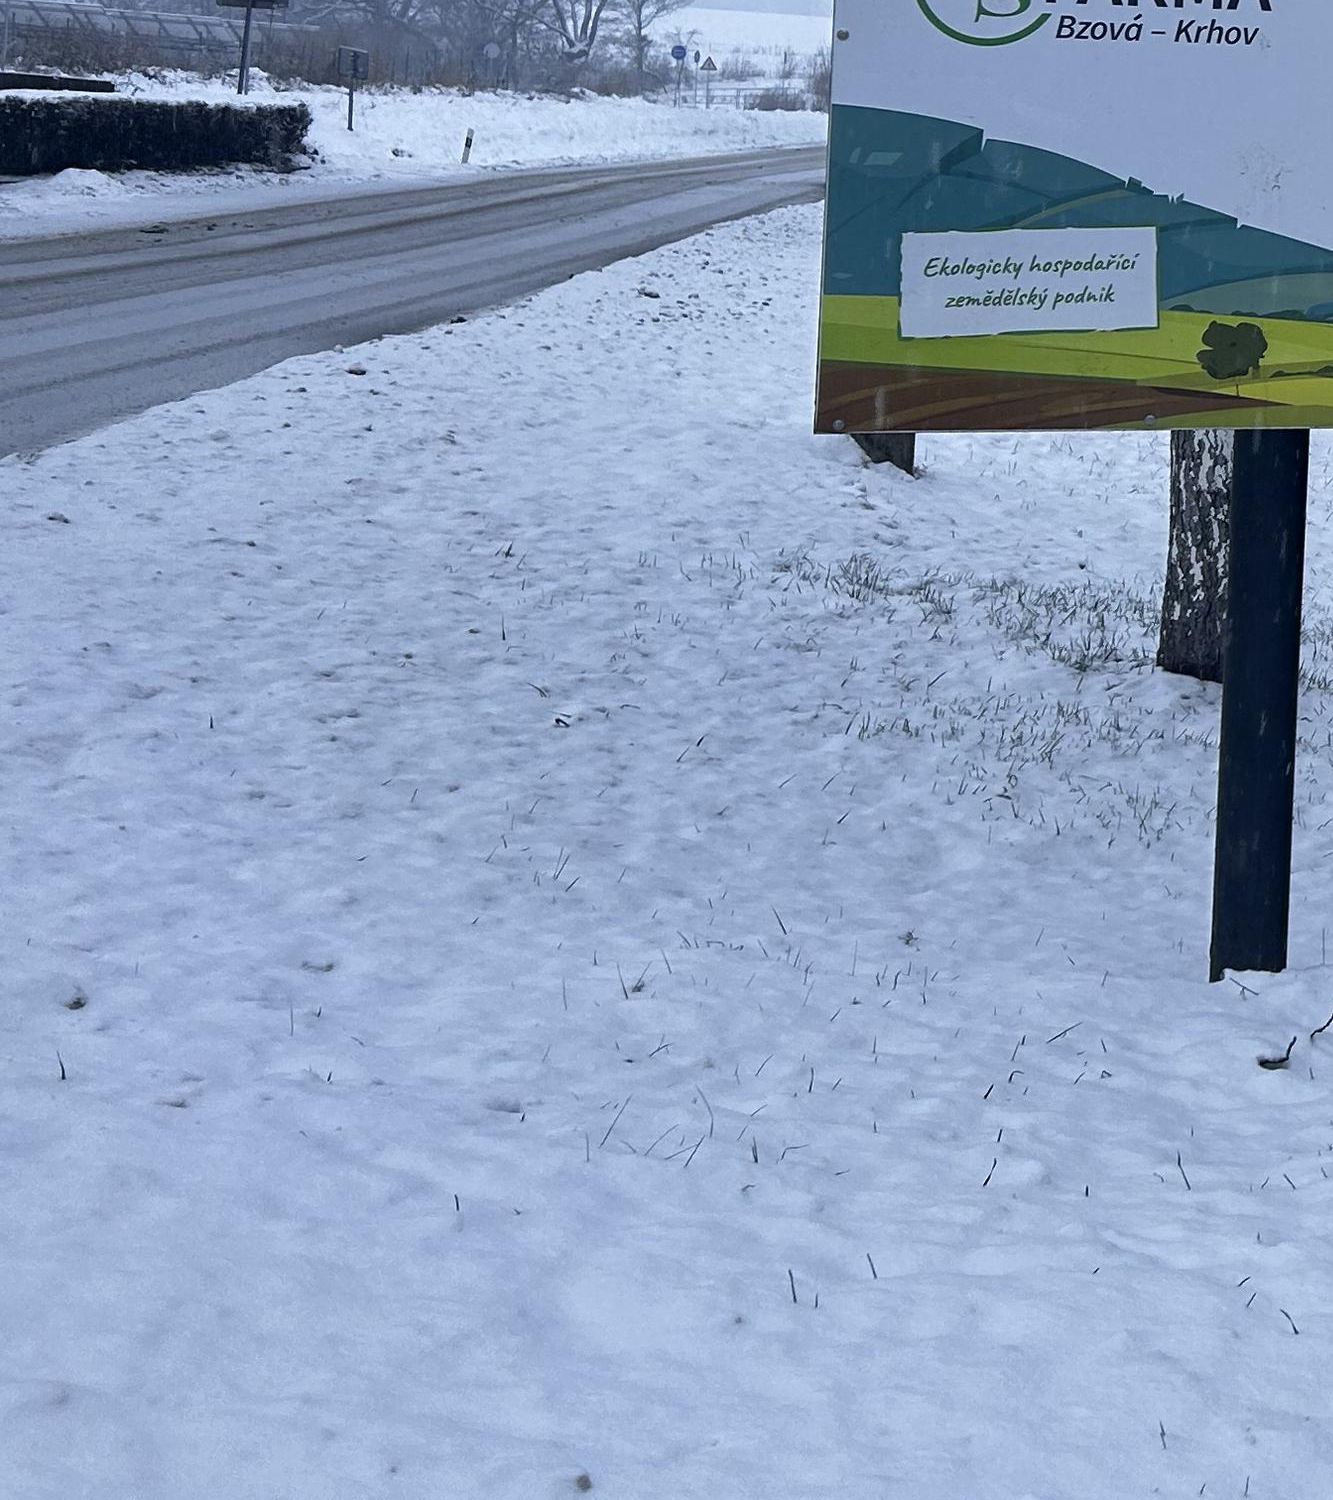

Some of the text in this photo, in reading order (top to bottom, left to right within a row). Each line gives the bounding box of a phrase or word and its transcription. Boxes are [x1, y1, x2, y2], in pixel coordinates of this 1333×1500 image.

[1055, 13, 1144, 42] Bzová
[1173, 18, 1260, 46] Krhov
[923, 252, 1142, 281] Ekologicky hospodařící
[944, 283, 1117, 311] zemědělský podnik
